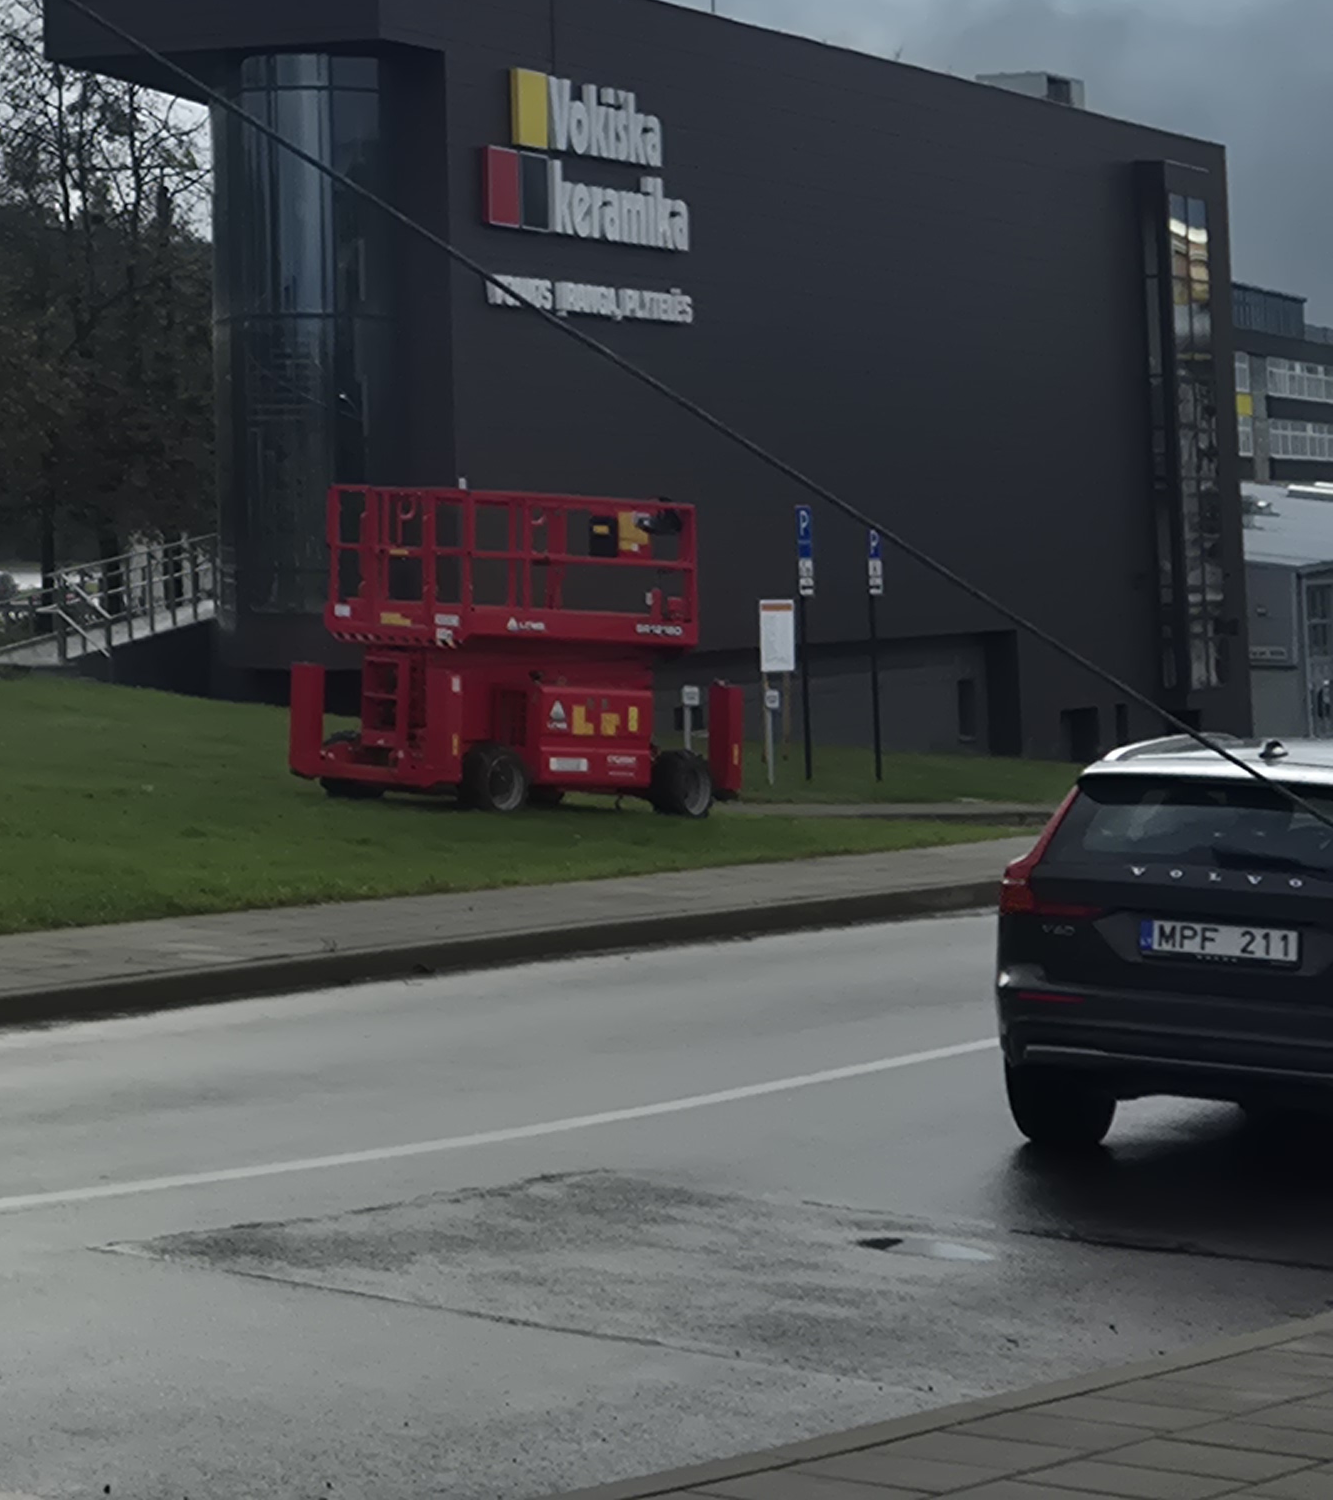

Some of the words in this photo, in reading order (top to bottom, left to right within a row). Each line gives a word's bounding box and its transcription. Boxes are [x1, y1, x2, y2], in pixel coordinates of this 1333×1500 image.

[548, 75, 662, 167] Vokiška
[549, 159, 689, 251] keramika
[800, 510, 809, 535] P
[870, 529, 879, 554] P
[1132, 866, 1303, 888] VOLVO
[1157, 923, 1219, 951] MPF
[1240, 930, 1290, 957] 211
